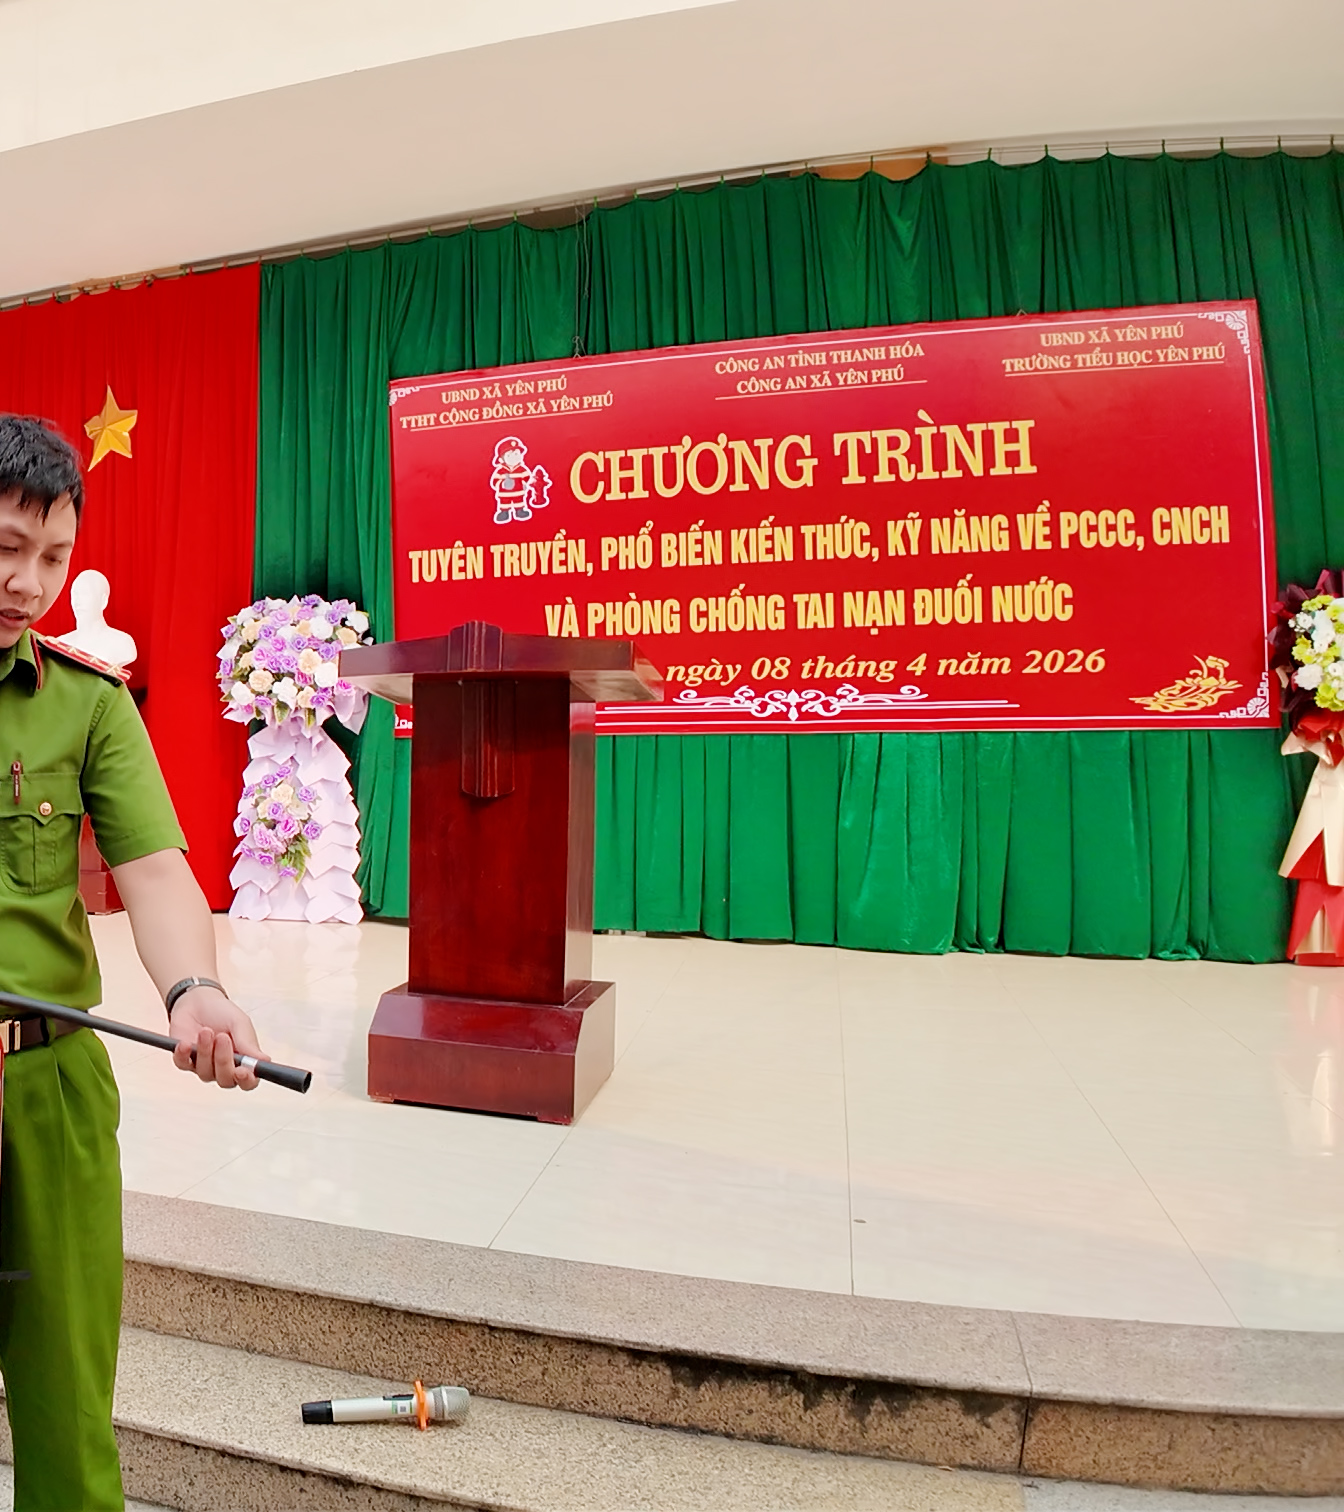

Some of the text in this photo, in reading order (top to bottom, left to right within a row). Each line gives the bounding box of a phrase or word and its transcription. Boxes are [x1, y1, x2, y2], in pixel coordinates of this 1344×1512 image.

[1040, 322, 1184, 347] UBND XÃ YÊN PHÚ
[715, 341, 925, 375] CÔNG AN TỈNH THANH HÓA
[1002, 344, 1225, 373] TRƯỜNG TIỂU HỌC YÊN PHÚ
[441, 375, 568, 404] UBND XÃ YÊN PHÚ
[736, 364, 904, 394] CÔNG AN XÃ YÊN PHÚ
[400, 391, 614, 429] TTHT CỘNG ĐỒNG XÃ YÊN PHÚ
[570, 409, 1037, 503] CHƯƠNG TRÌNH
[409, 500, 1231, 583] TUYÊN TRUYỀN, PHỔ BIẾN KIẾN THỨC, KỸ NĂNG VỀ PCCC, CNCH
[545, 573, 1073, 638] VÀ PHÒNG CHỐNG TAI NẠN ĐUỐI NƯỚC
[665, 648, 1106, 687] ngày 08 tháng 4 năm 2026
